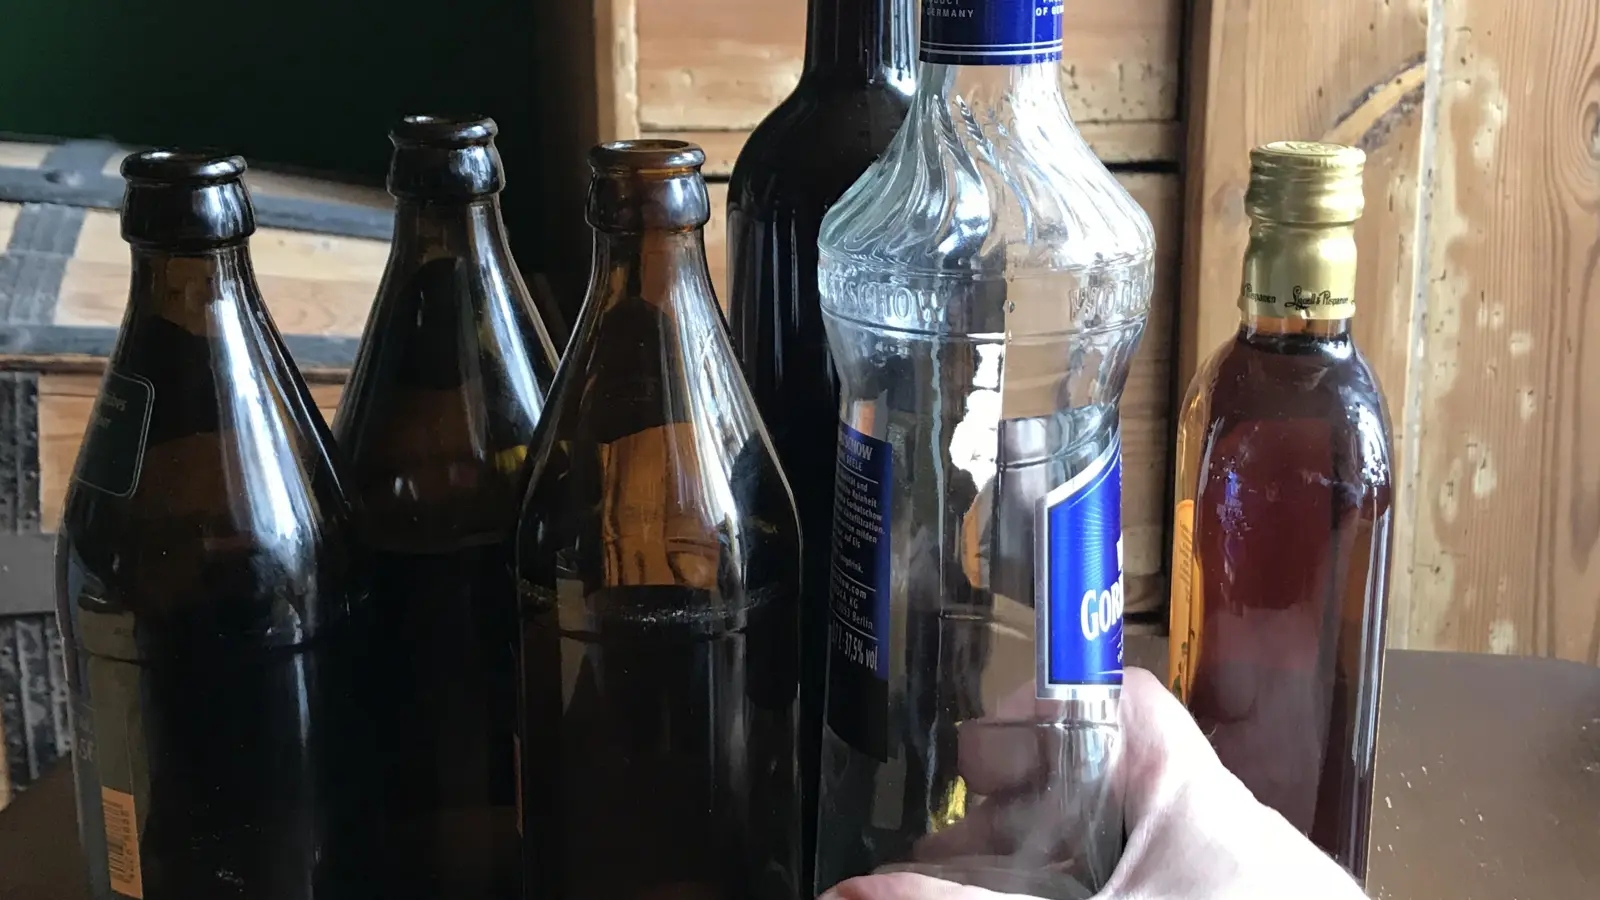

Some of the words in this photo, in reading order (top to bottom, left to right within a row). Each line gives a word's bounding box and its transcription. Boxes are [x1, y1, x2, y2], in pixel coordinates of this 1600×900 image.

[926, 8, 974, 18] GERMANY
[1035, 7, 1048, 16] OF
[852, 611, 873, 630] Berlin
[866, 645, 878, 671] vol
